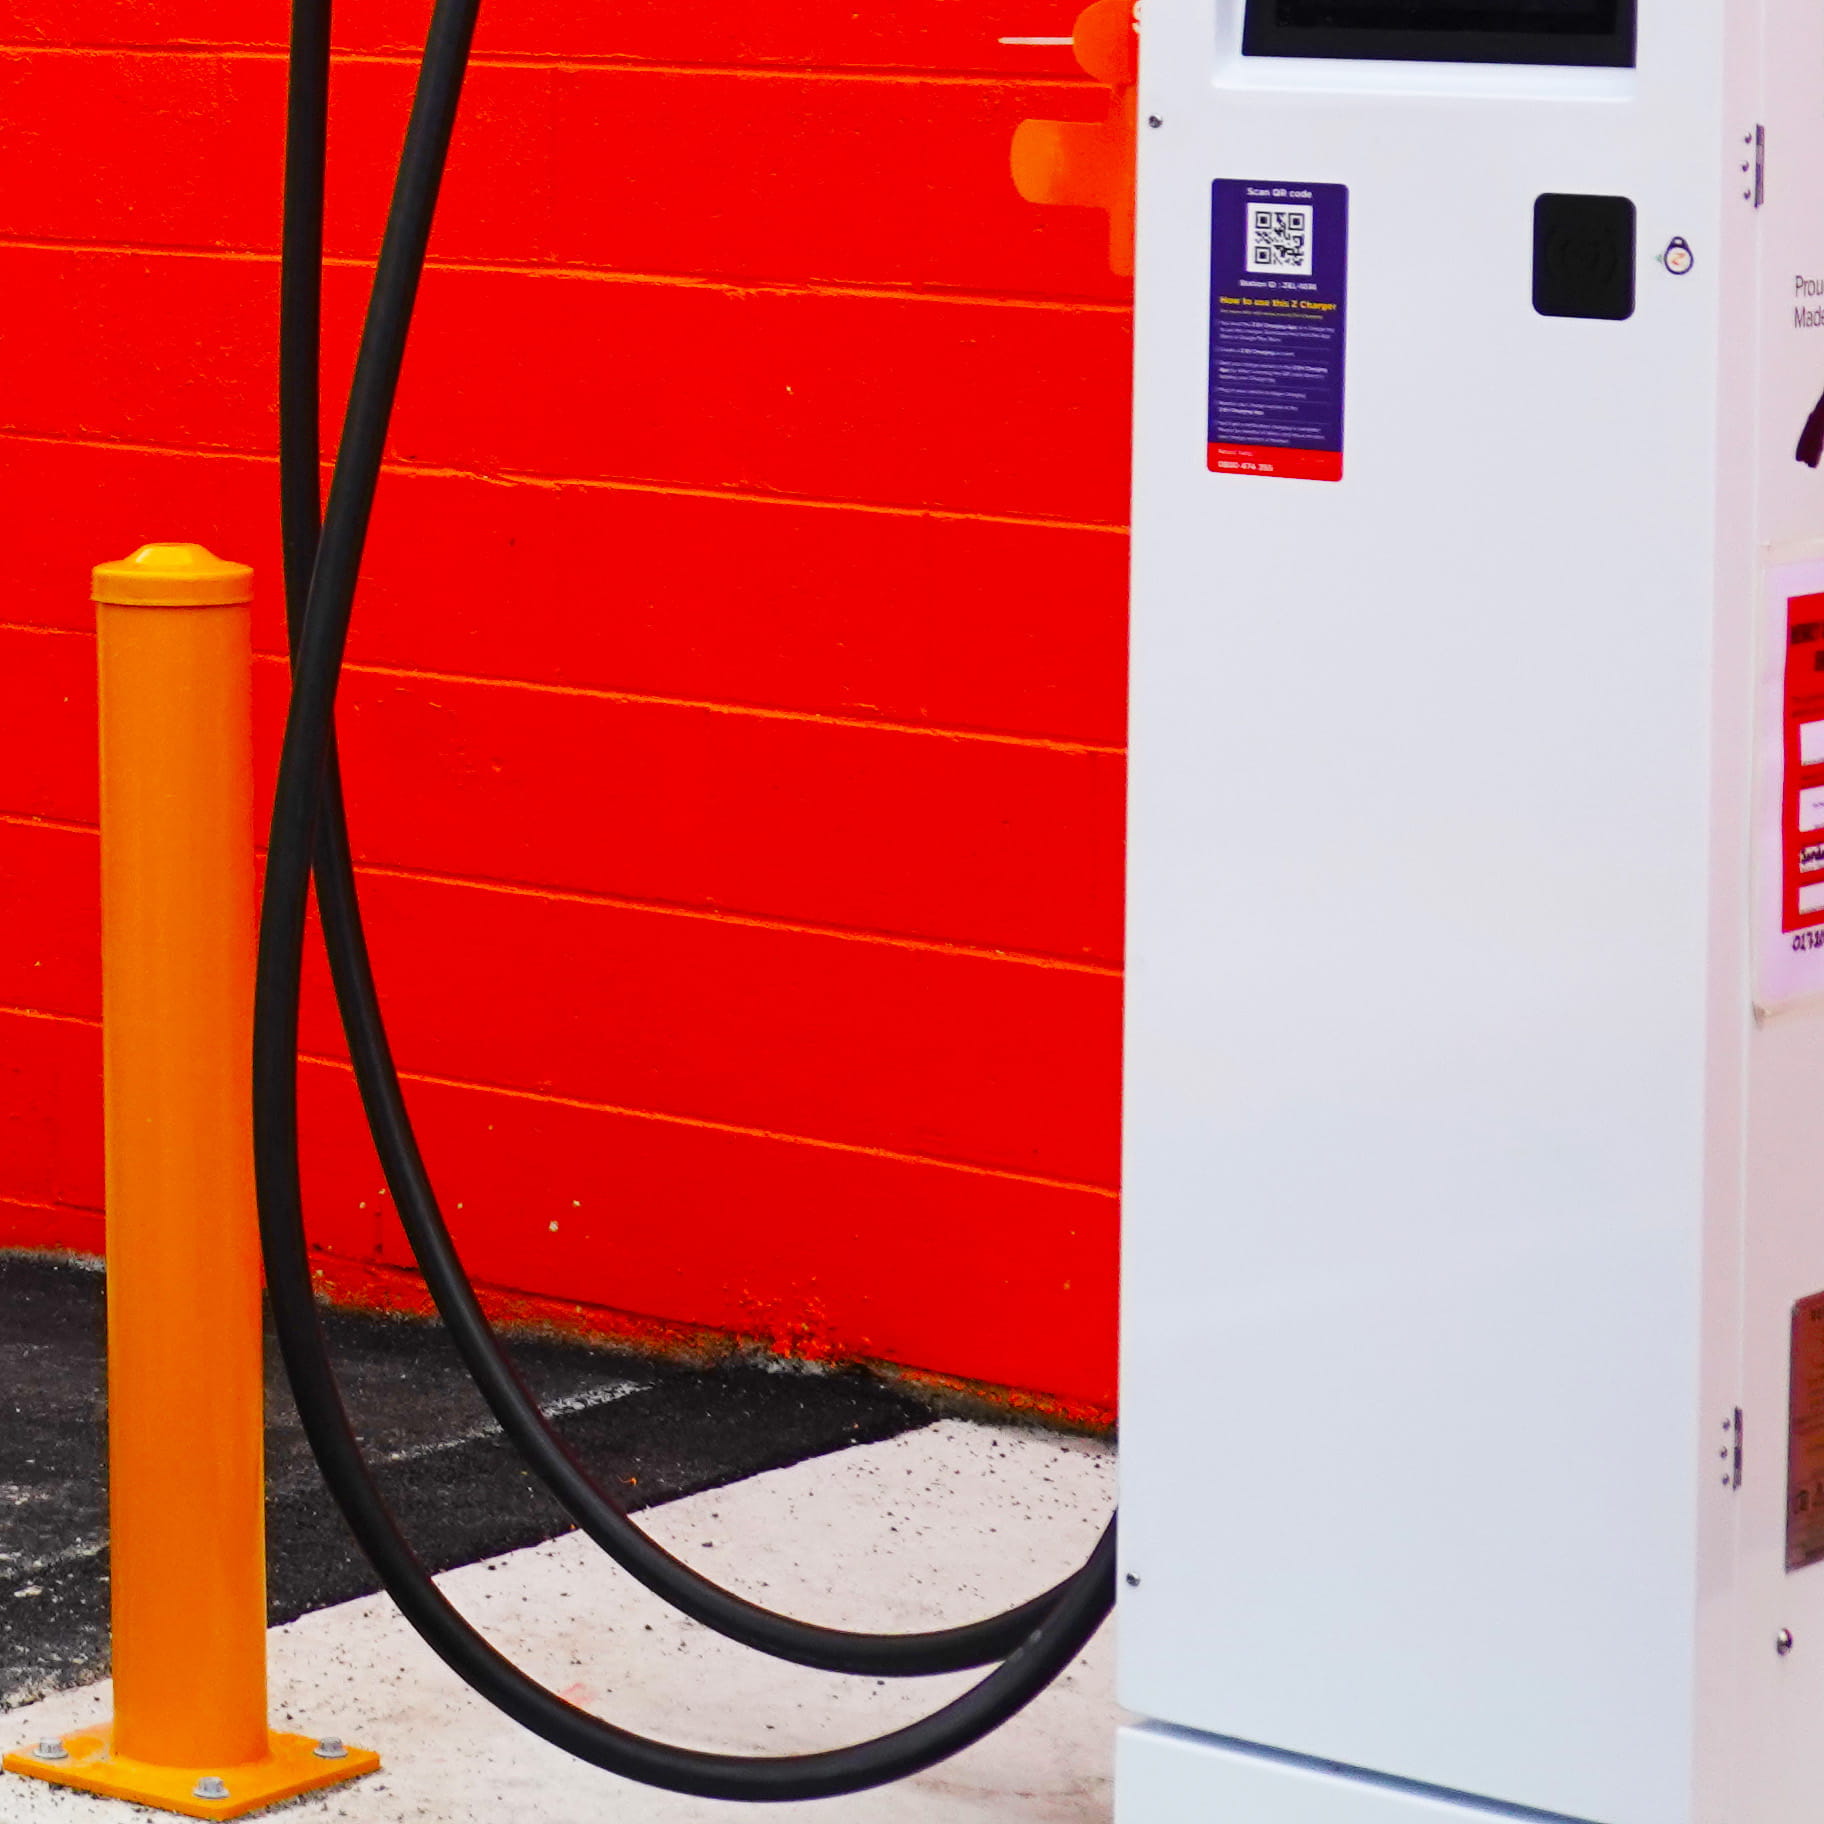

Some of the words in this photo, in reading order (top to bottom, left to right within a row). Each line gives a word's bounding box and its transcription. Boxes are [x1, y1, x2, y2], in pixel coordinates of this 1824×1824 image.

[1246, 187, 1270, 196] Scan
[1272, 188, 1288, 197] QR
[1289, 189, 1312, 199] code
